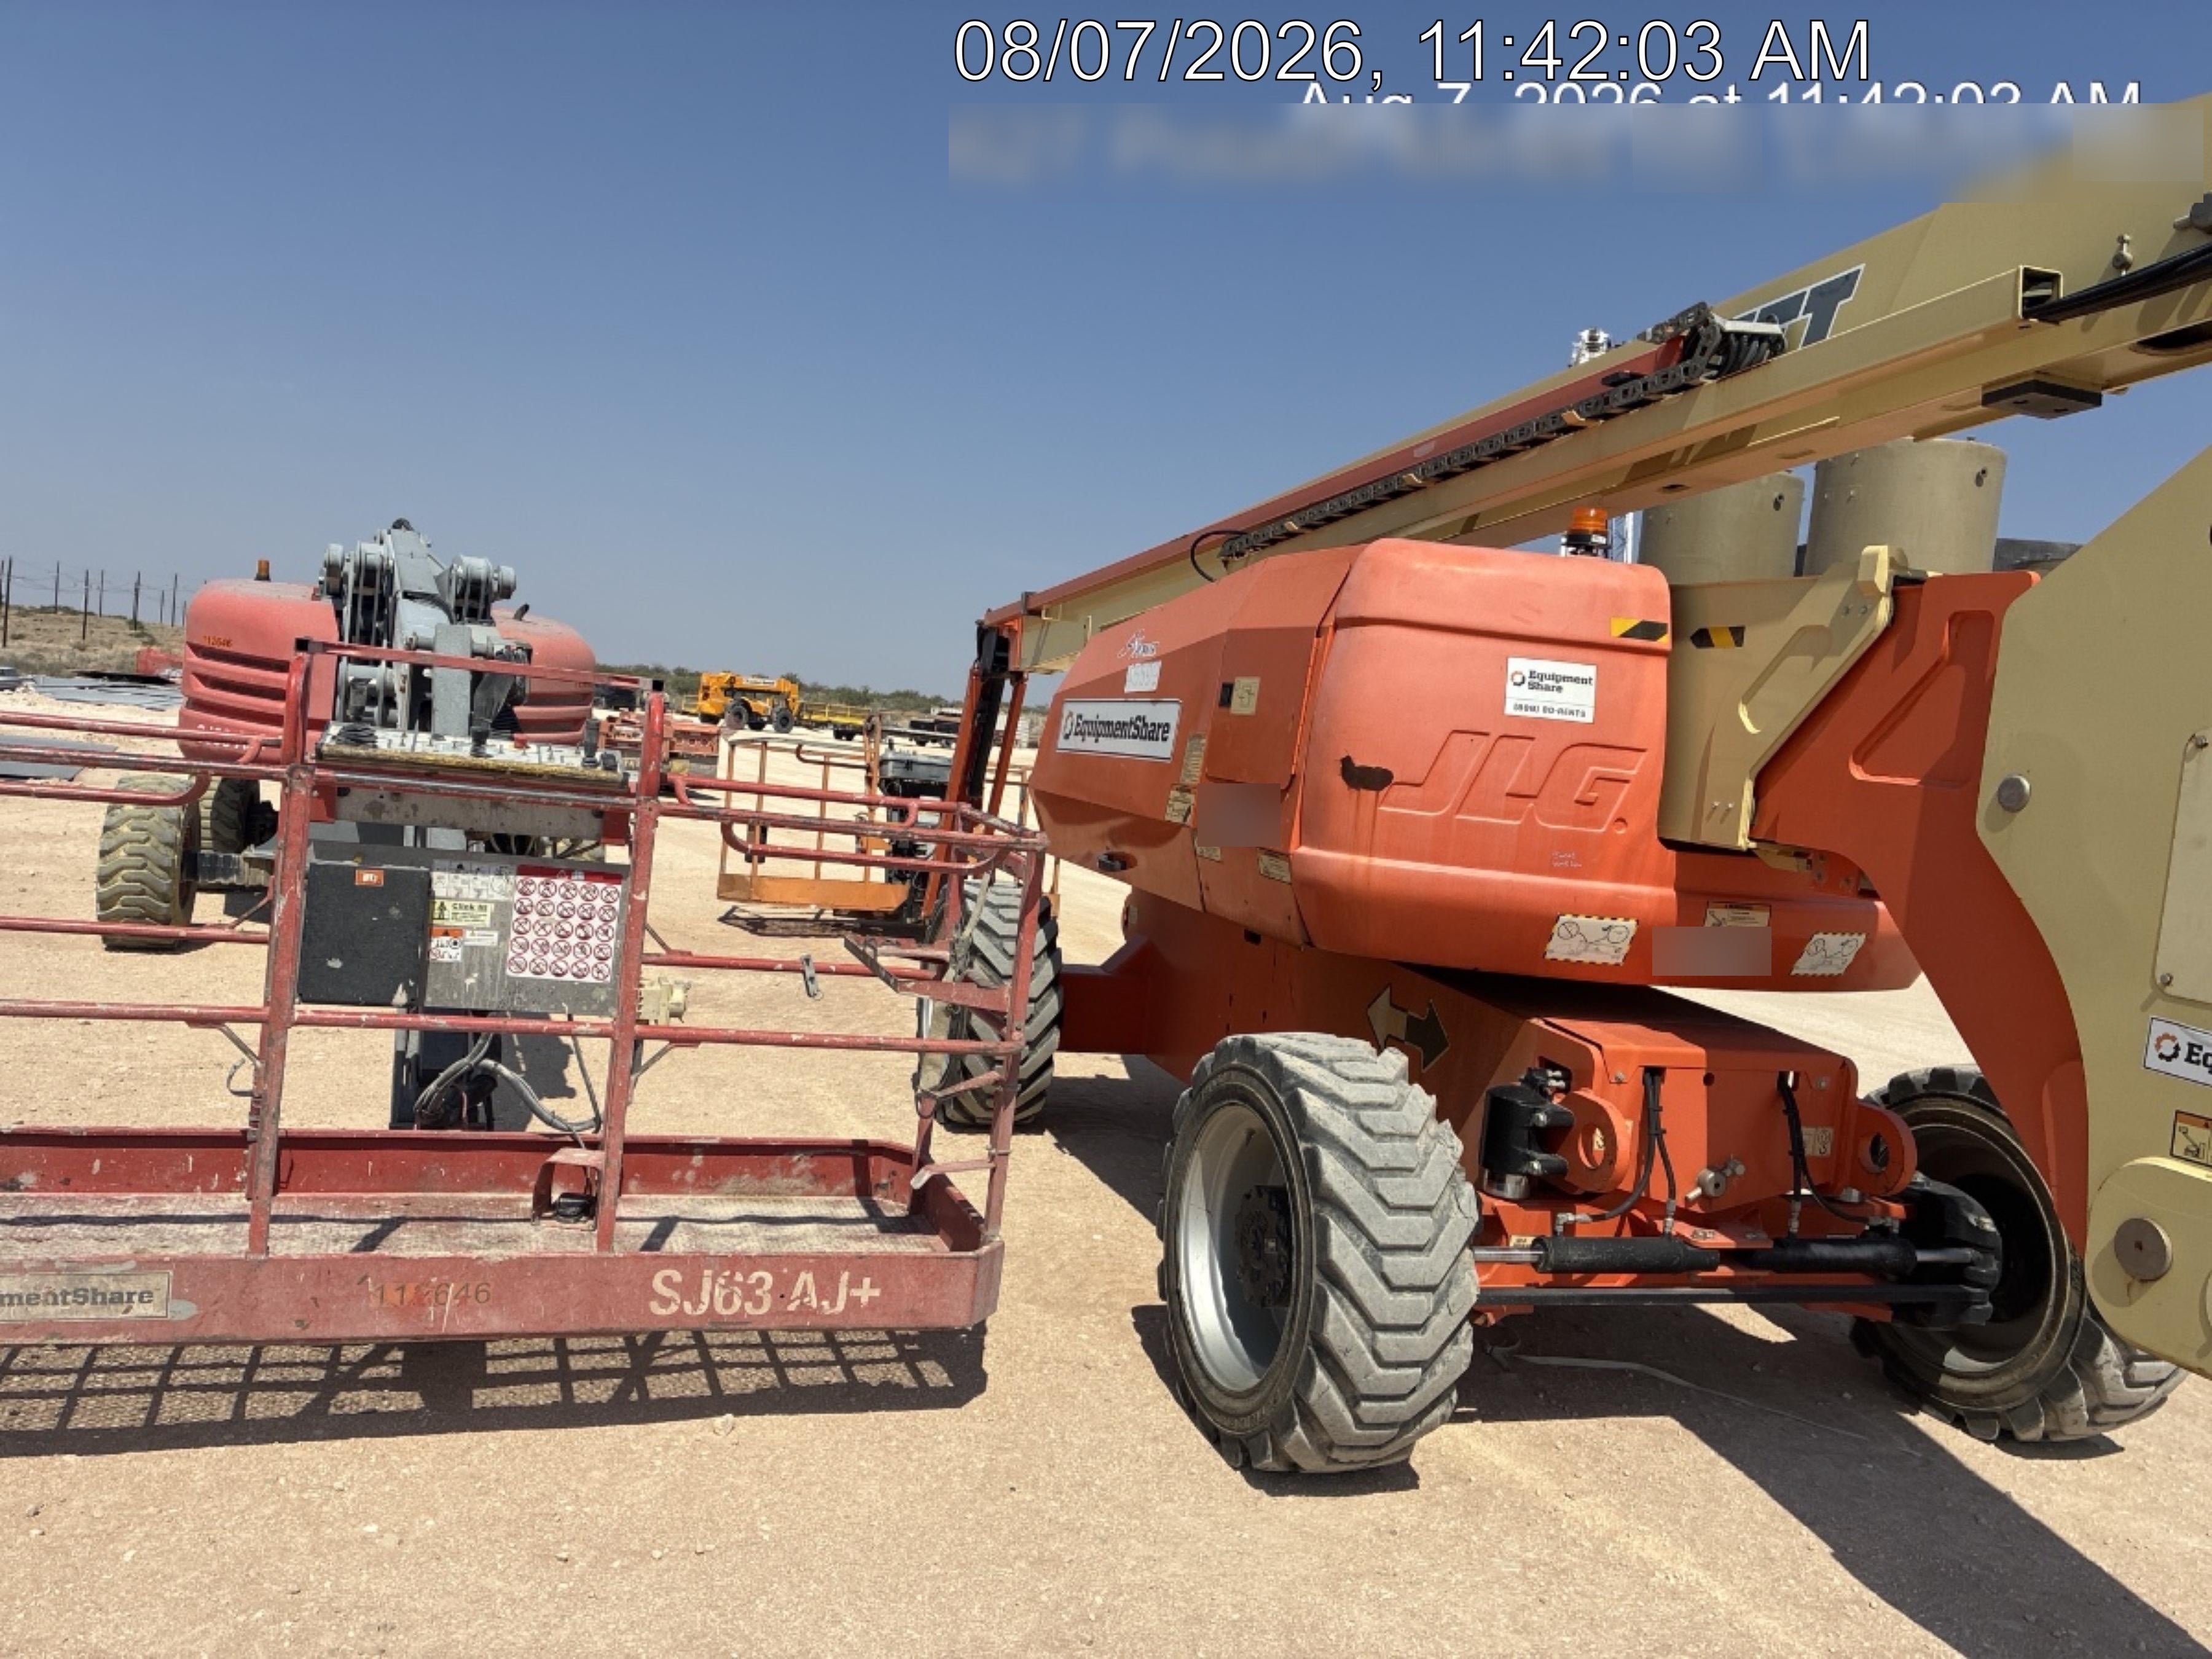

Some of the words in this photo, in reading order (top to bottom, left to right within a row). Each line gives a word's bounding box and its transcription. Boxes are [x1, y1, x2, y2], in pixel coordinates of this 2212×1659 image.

[1528, 681, 1563, 693] Share
[1529, 670, 1593, 686] Equipment
[1074, 713, 1171, 743] EquipmentShare
[1378, 729, 1649, 833] JLG
[648, 1269, 774, 1316] SJ63
[786, 1270, 882, 1315] AJ+
